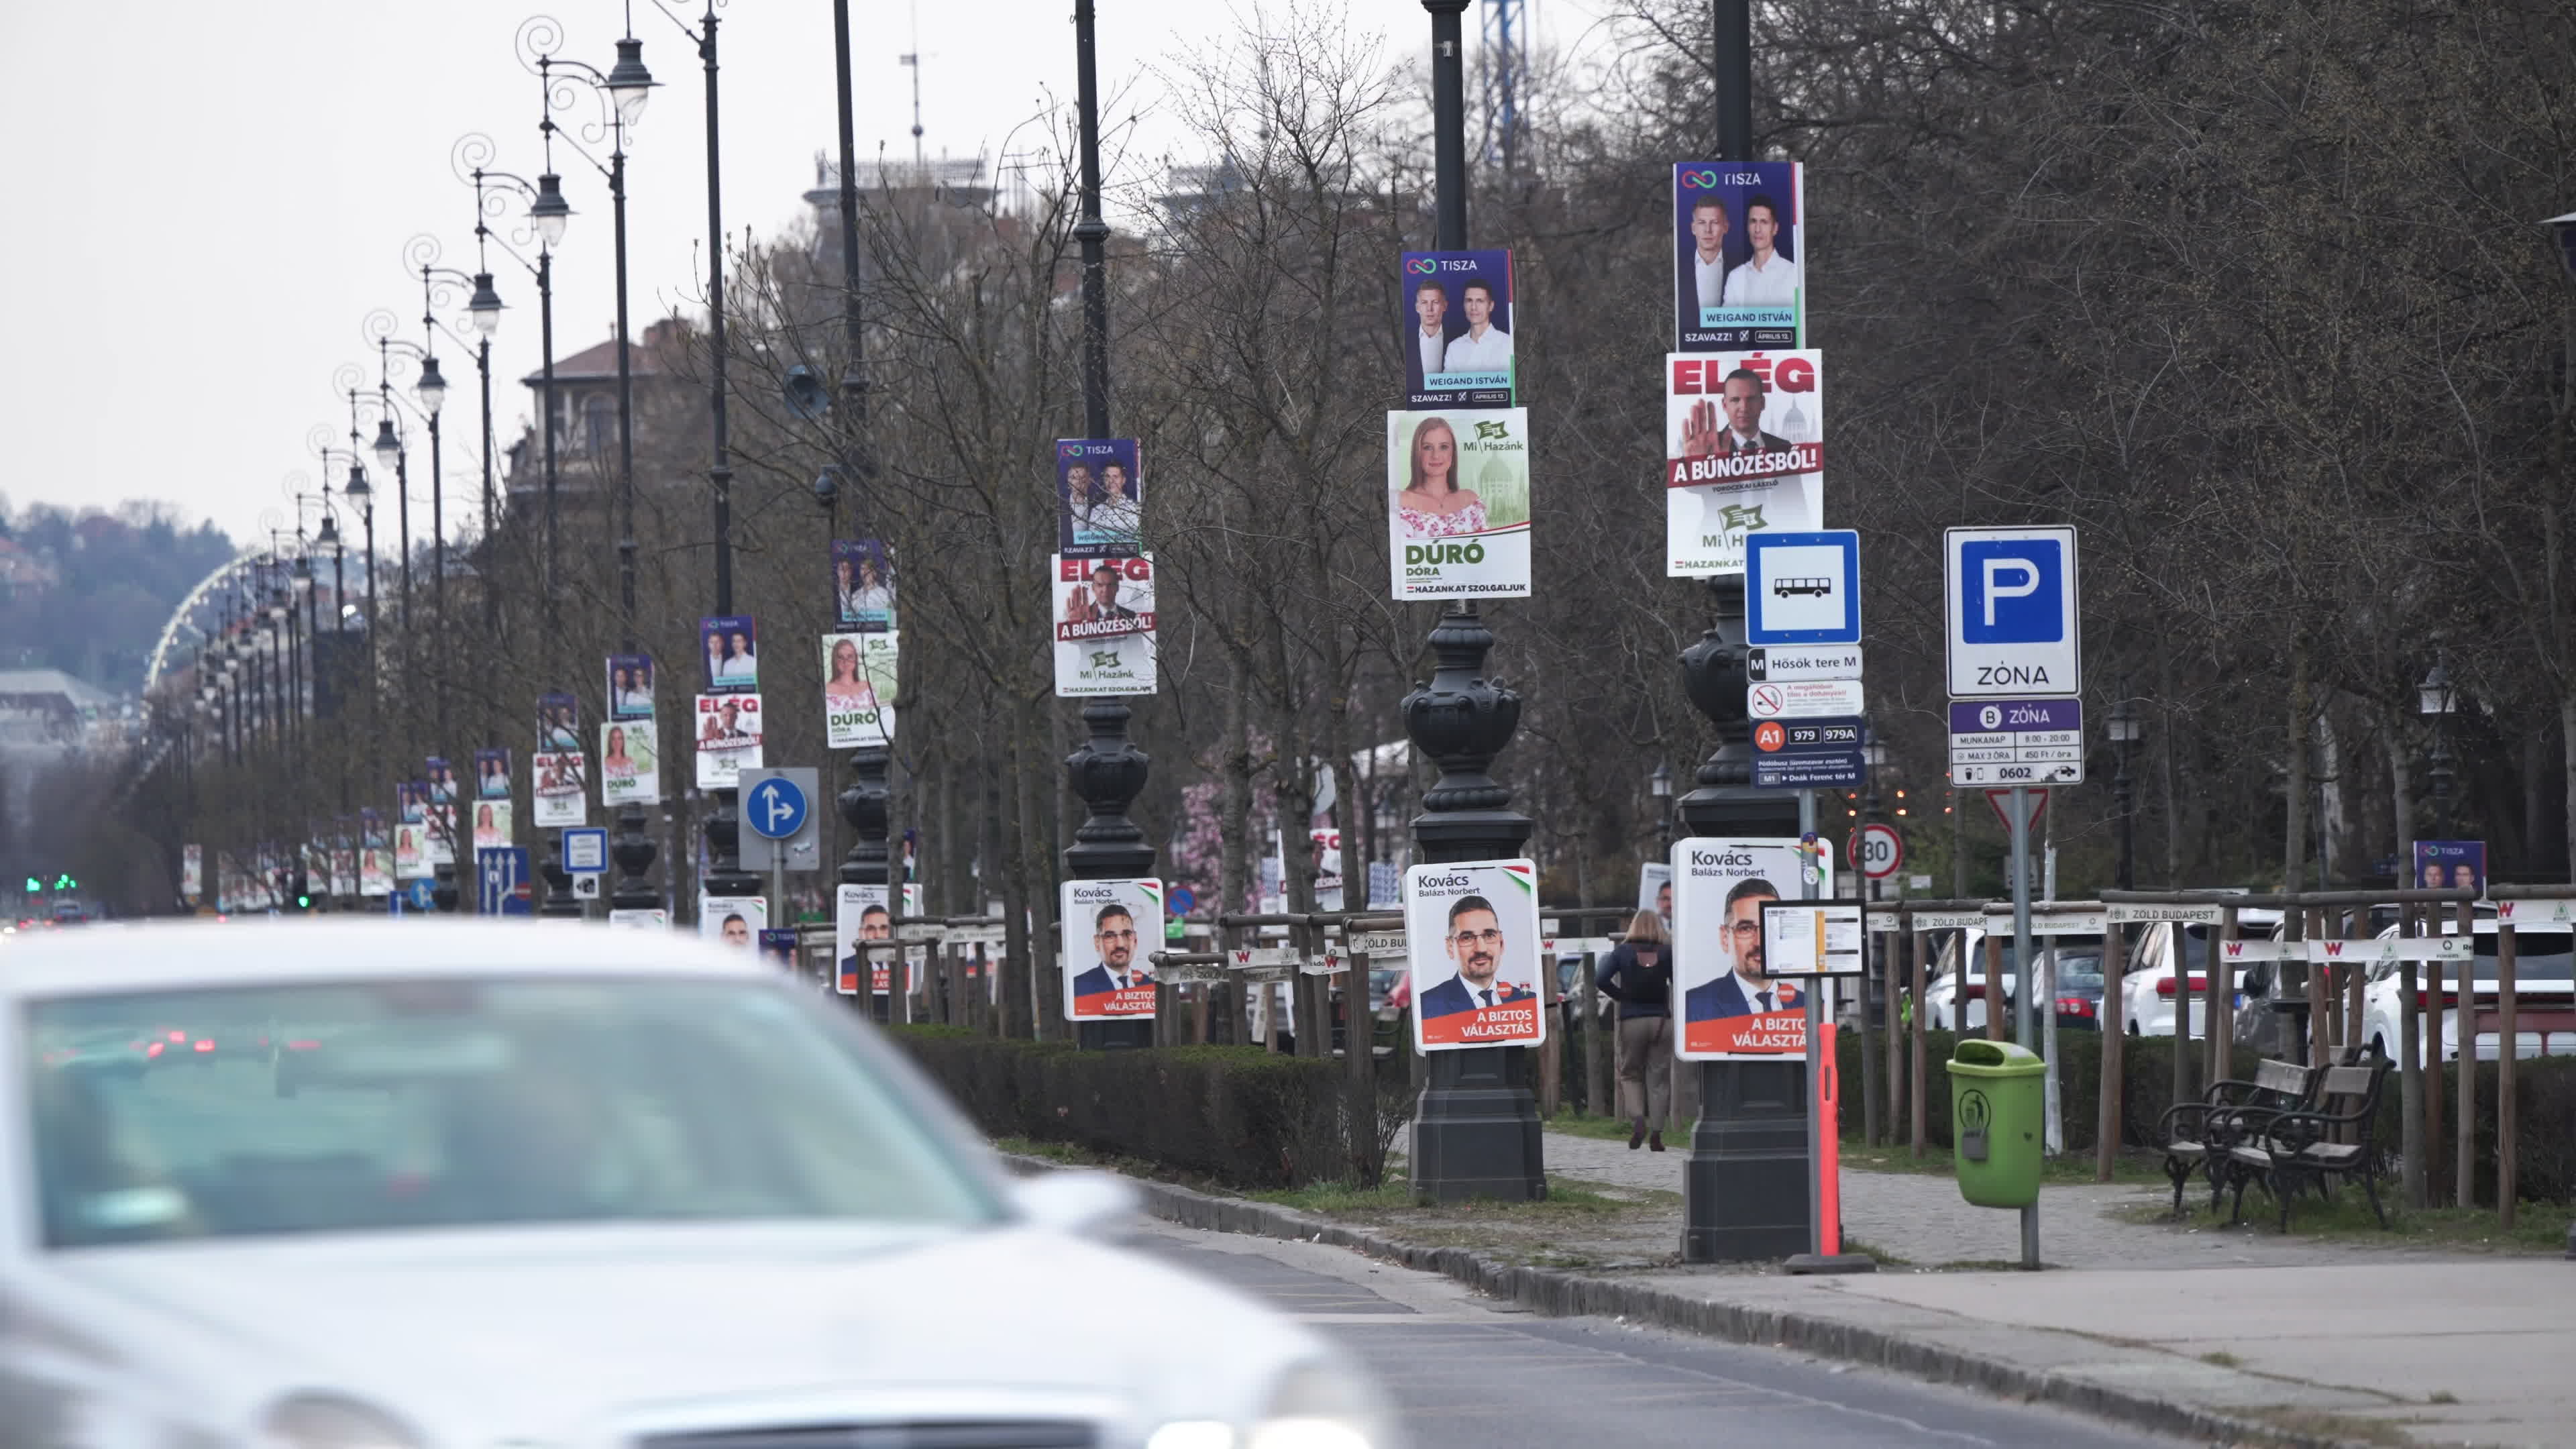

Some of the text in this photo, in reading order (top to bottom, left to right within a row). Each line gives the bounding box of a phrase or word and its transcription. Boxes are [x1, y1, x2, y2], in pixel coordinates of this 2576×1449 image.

[1725, 173, 1761, 185] TISZA
[1441, 260, 1477, 271] TISZA
[1707, 311, 1792, 322] WEIGAND ISTVÁN
[1685, 333, 1732, 341] SZAVAZZ!
[1674, 352, 1815, 394] ELÉG
[1430, 376, 1507, 386] WEIGAND ISTVÁN
[1411, 392, 1452, 402] SZAVAZZ!
[1086, 446, 1114, 454] TISZA
[1464, 441, 1524, 451] Mi Hazánk
[1674, 445, 1817, 482] A BŰNÖZÉSBŐL!
[1703, 535, 1721, 547] Mi
[1405, 539, 1485, 565] DÚRÓ
[1406, 566, 1440, 576] DÓRA
[1983, 557, 2040, 626] P
[1061, 627, 1070, 637] A
[1751, 659, 1764, 670] M
[1772, 657, 1856, 669] Hősök tere M
[1978, 660, 2049, 685] ZÓNA
[1986, 706, 2050, 724] B ZÓNA
[1760, 729, 1855, 743] A1 979 979A
[1960, 736, 2006, 745] MUNKANAP
[2049, 734, 2070, 742] 20:00
[1968, 751, 1985, 760] MAX
[1986, 751, 1992, 759] 3
[1994, 750, 2010, 759] ÓRA
[2057, 750, 2072, 758] óra
[2000, 767, 2031, 778] 0602
[1864, 841, 1888, 861] 30
[1691, 850, 1752, 865] Kovács
[1691, 867, 1765, 877] Balázs Norbert
[1418, 873, 1468, 888] Kovács
[1074, 886, 1112, 898] Kovács
[1418, 887, 1481, 897] Balázs Norbert
[2162, 910, 2216, 920] BUDAPEST
[1956, 917, 1988, 926] BUDAPE
[1477, 1009, 1532, 1022] A BIZTOS
[1461, 1020, 1533, 1037] VÁLASZTÁS
[1752, 1018, 1806, 1031] A BIZTO
[1732, 1031, 1807, 1047] VÁLASZTÁ
